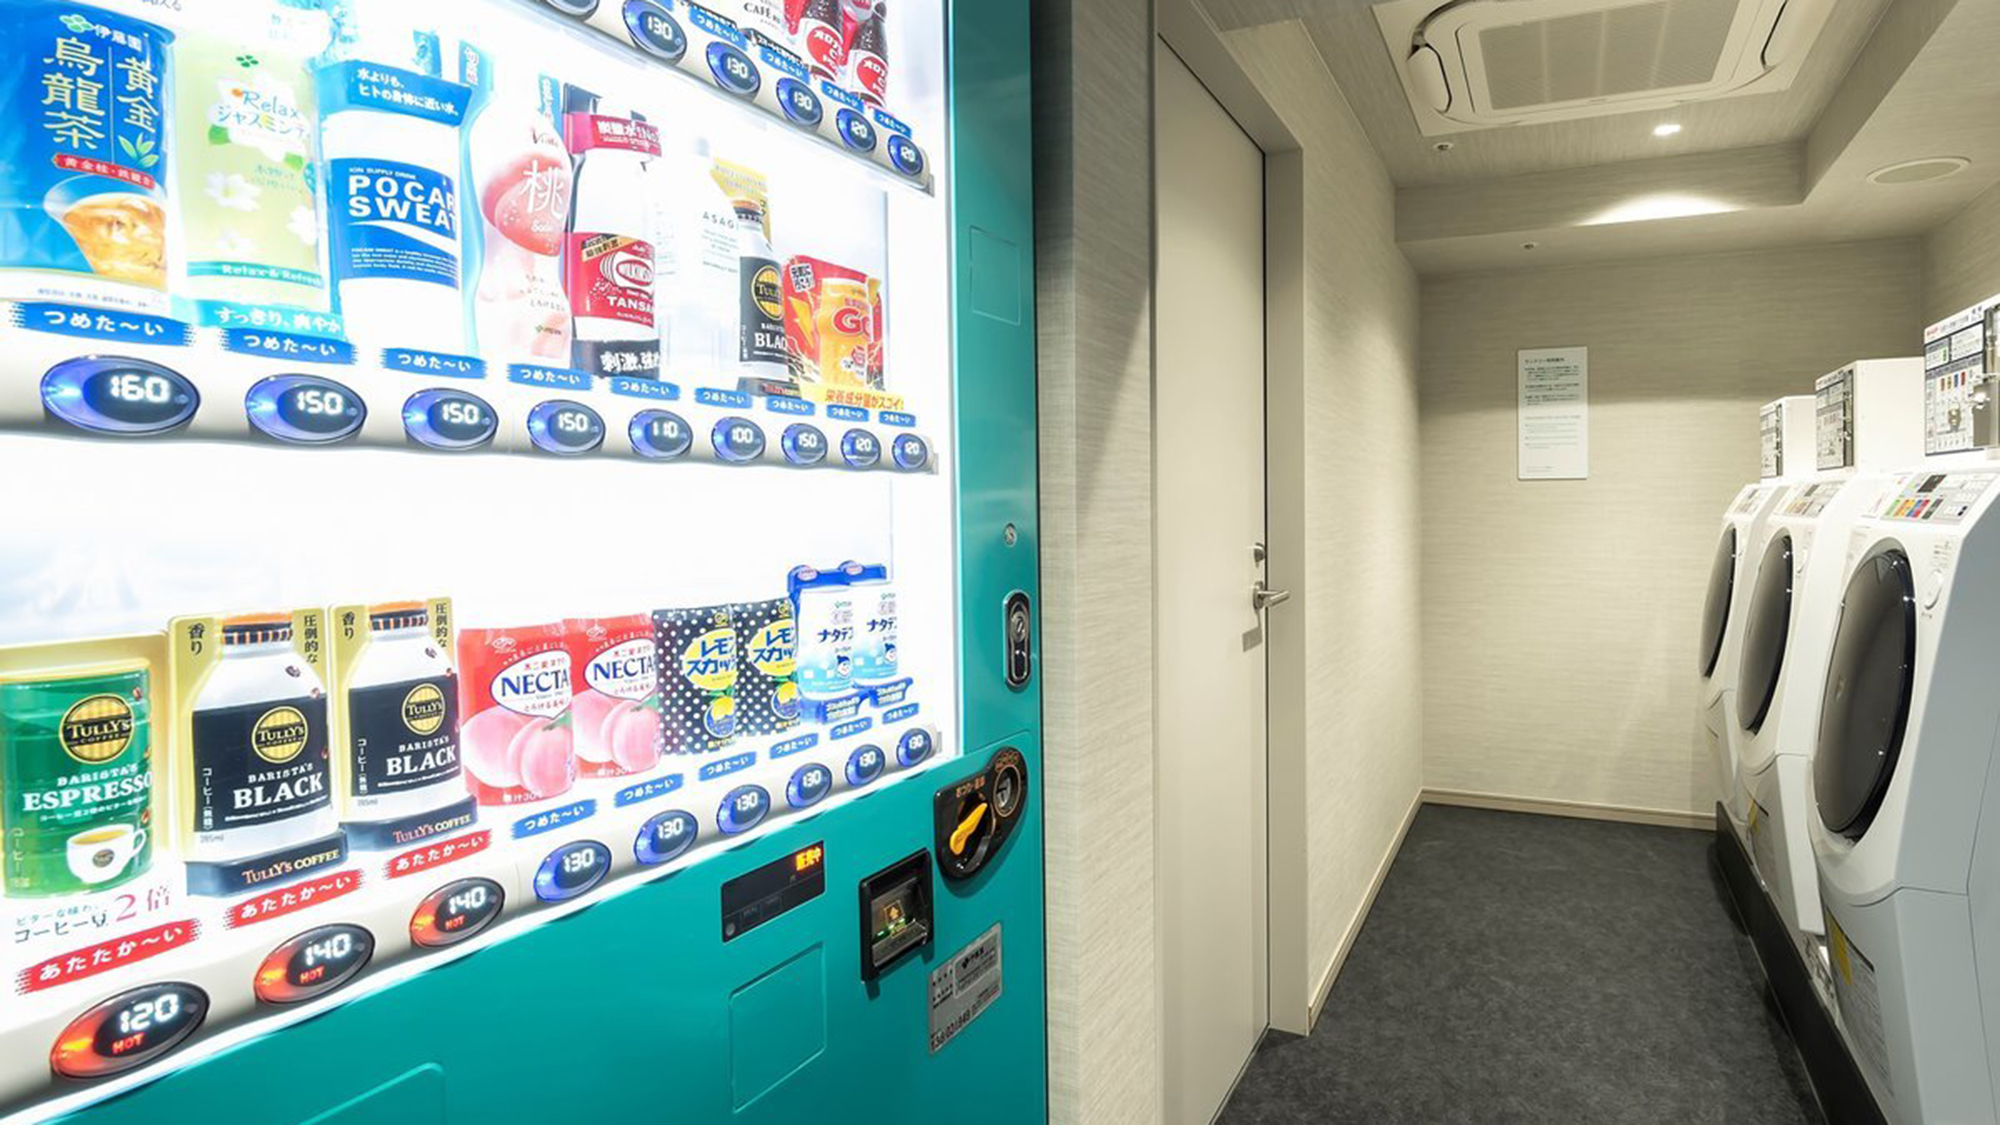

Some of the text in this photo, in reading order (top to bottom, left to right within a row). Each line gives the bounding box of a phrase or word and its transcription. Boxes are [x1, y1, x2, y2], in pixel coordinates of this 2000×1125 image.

[648, 17, 672, 39] 130
[727, 57, 747, 78] 130
[242, 90, 299, 119] Relax
[794, 91, 812, 110] 130
[519, 159, 565, 219] 桃
[44, 311, 163, 336] つめた〜い
[244, 333, 336, 355] つめた〜い
[397, 352, 470, 372] つめた〜い
[109, 371, 170, 403] 160
[520, 367, 580, 385] つめた〜い
[296, 388, 344, 416] 150
[441, 401, 479, 425] 150
[558, 411, 588, 432] 150
[652, 420, 678, 438] 110
[732, 426, 753, 443] 100
[798, 432, 818, 448] 150
[342, 611, 355, 641] 香り
[436, 602, 448, 648] 圧倒的な
[866, 617, 897, 632] ナタデ
[188, 623, 205, 656] 香り
[304, 614, 319, 664] 圧倒的な
[501, 668, 570, 697] NECTA
[386, 745, 456, 776] BLACK
[859, 750, 876, 766] 130
[233, 772, 323, 809] BLACK
[802, 770, 821, 787] 130
[23, 771, 153, 811] ESPRESSO
[736, 792, 759, 811] 130
[435, 814, 471, 832] COFFEE
[658, 817, 684, 839] 130
[294, 850, 340, 870] COFFEE
[396, 834, 484, 871] あたたか〜い
[563, 848, 595, 872] 130
[242, 876, 352, 919] あたたか〜い
[449, 886, 486, 914] 140
[445, 915, 465, 930] HOT
[39, 927, 184, 981] あたたか〜い
[305, 934, 350, 966] 140
[300, 966, 324, 984] HOT
[120, 994, 178, 1033] 120
[112, 1033, 145, 1054] HOT
